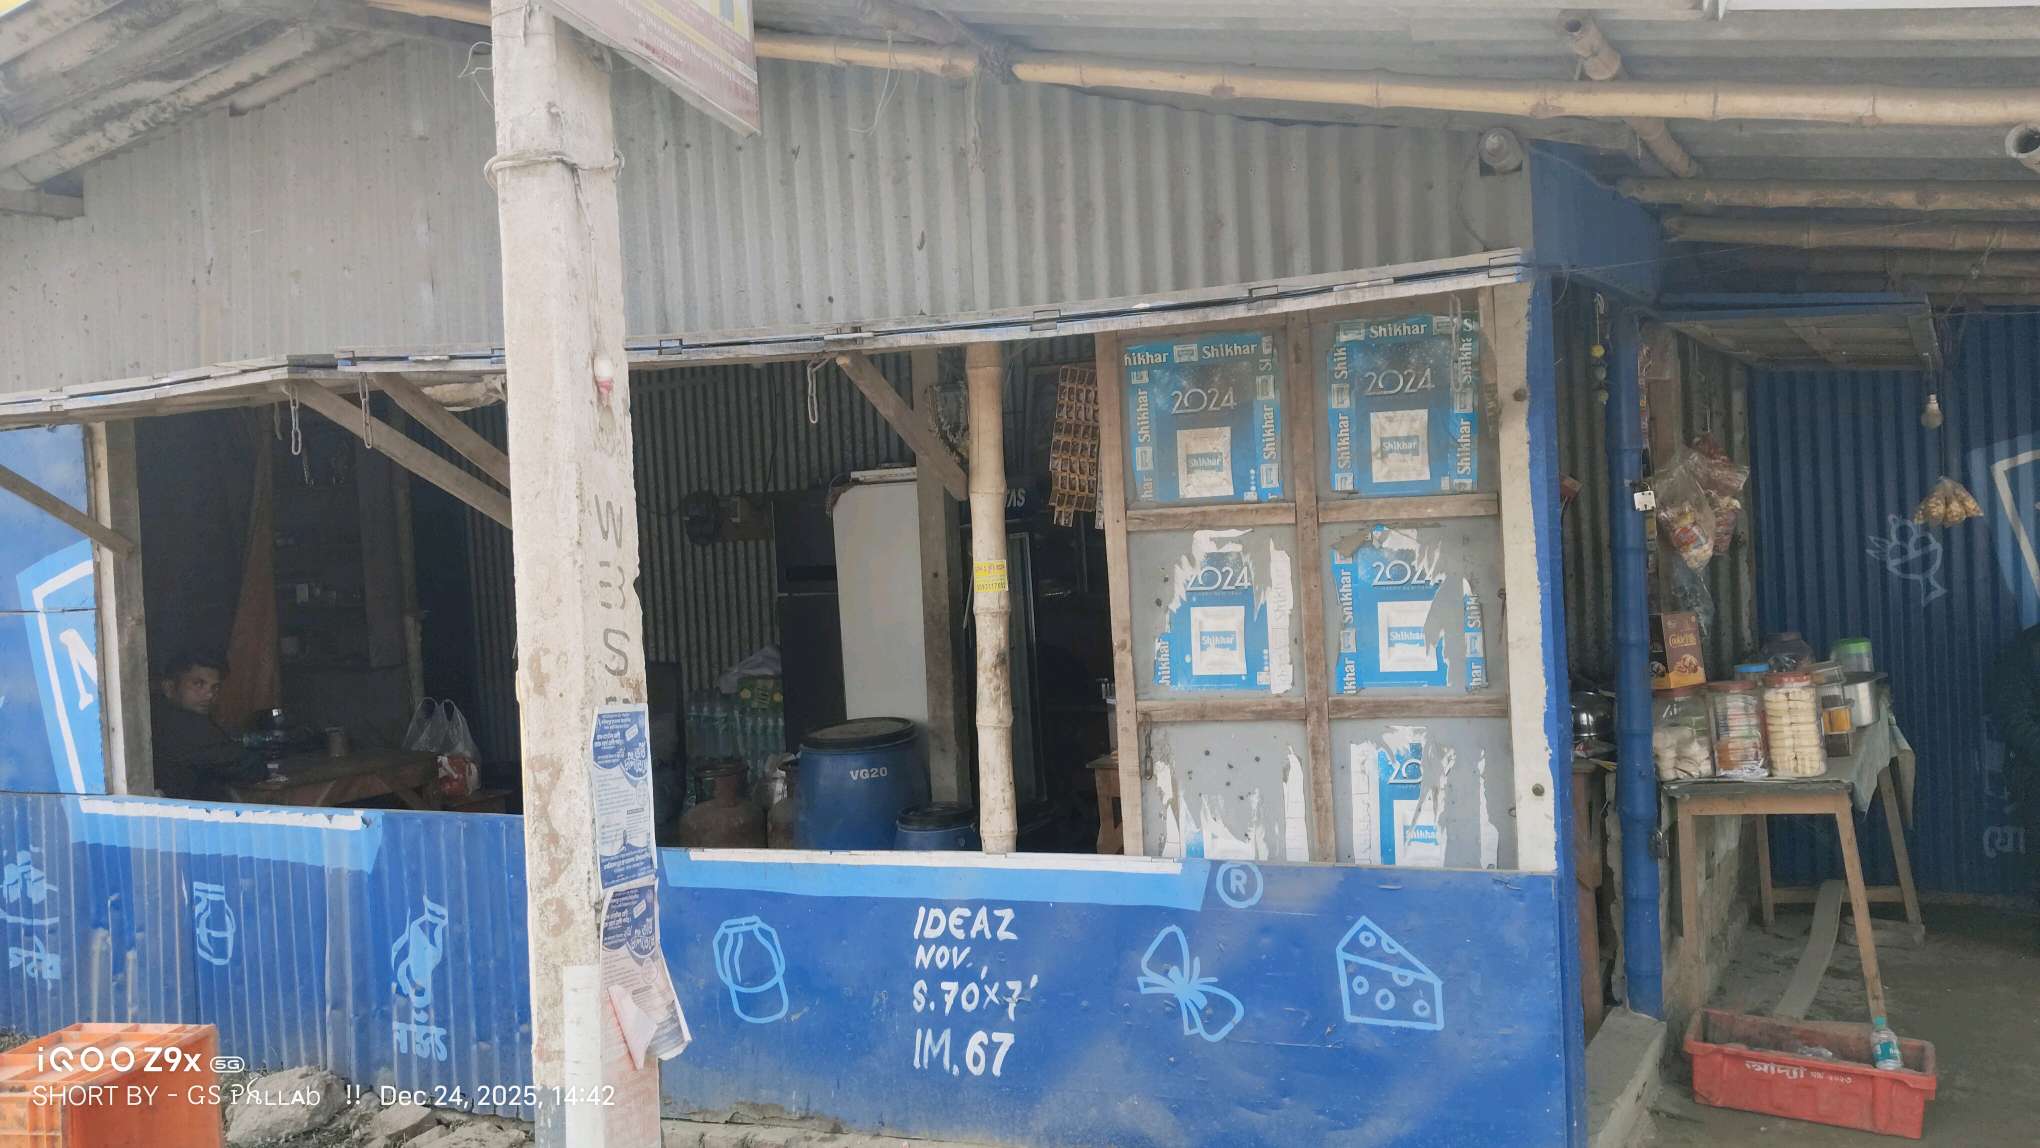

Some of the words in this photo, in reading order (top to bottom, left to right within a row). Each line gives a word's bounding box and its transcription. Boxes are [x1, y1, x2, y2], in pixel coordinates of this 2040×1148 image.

[1370, 322, 1427, 338] Shikhar
[1124, 352, 1169, 367] hikhar
[1202, 343, 1258, 360] Shikhar
[1333, 345, 1349, 380] Shik
[1363, 367, 1436, 396] 2024
[1136, 387, 1151, 443] Shikhar
[1171, 386, 1237, 415] 2024
[1261, 404, 1276, 460] Shikhar
[1337, 413, 1351, 470] Shikhar
[1457, 418, 1472, 475] Shikhar
[1339, 568, 1354, 624] Shikhar
[1157, 640, 1171, 686] hikhar
[1343, 657, 1357, 694] ikhar
[849, 767, 888, 781] VG20
[913, 905, 1018, 941] IDEAZ
